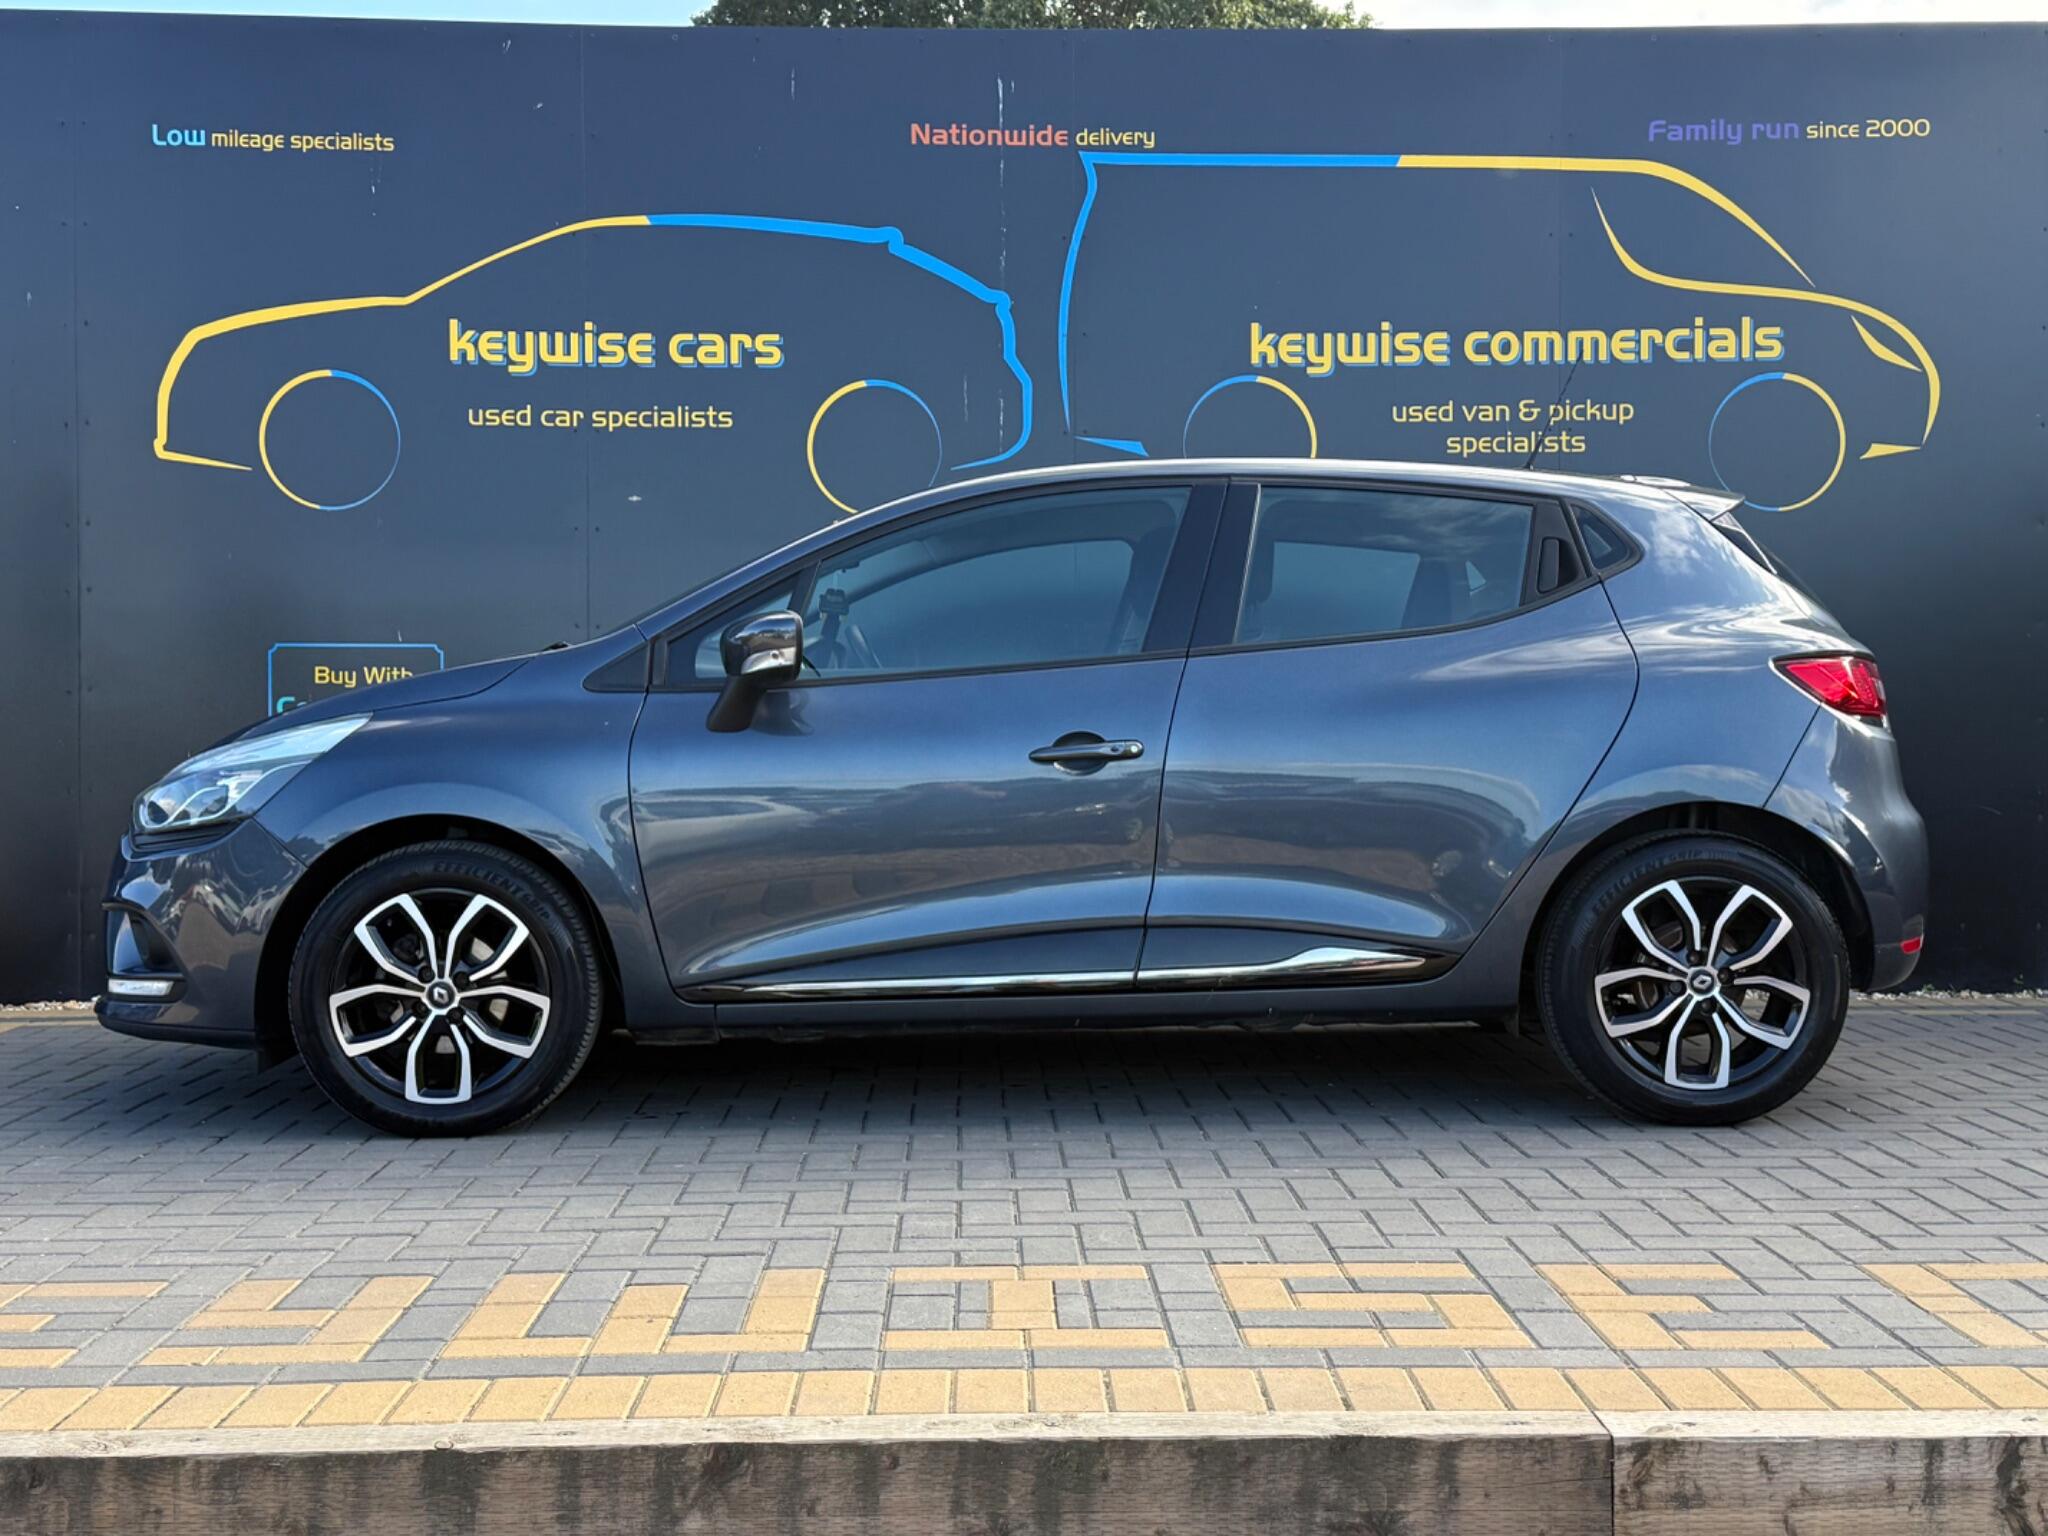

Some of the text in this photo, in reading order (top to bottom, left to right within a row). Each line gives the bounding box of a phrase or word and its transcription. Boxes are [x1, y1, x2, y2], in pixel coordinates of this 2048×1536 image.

[152, 124, 395, 153] Low mileage specialists
[910, 123, 1156, 151] Nationwide delivery
[1648, 118, 1931, 145] Family run since 2000
[448, 318, 785, 377] keywise cars
[1250, 315, 1785, 378] keywise commercials
[468, 403, 734, 432] used car specialists
[1392, 398, 1635, 426] used van & pickup
[1446, 430, 1586, 458] specialists
[314, 665, 358, 688] Buy
